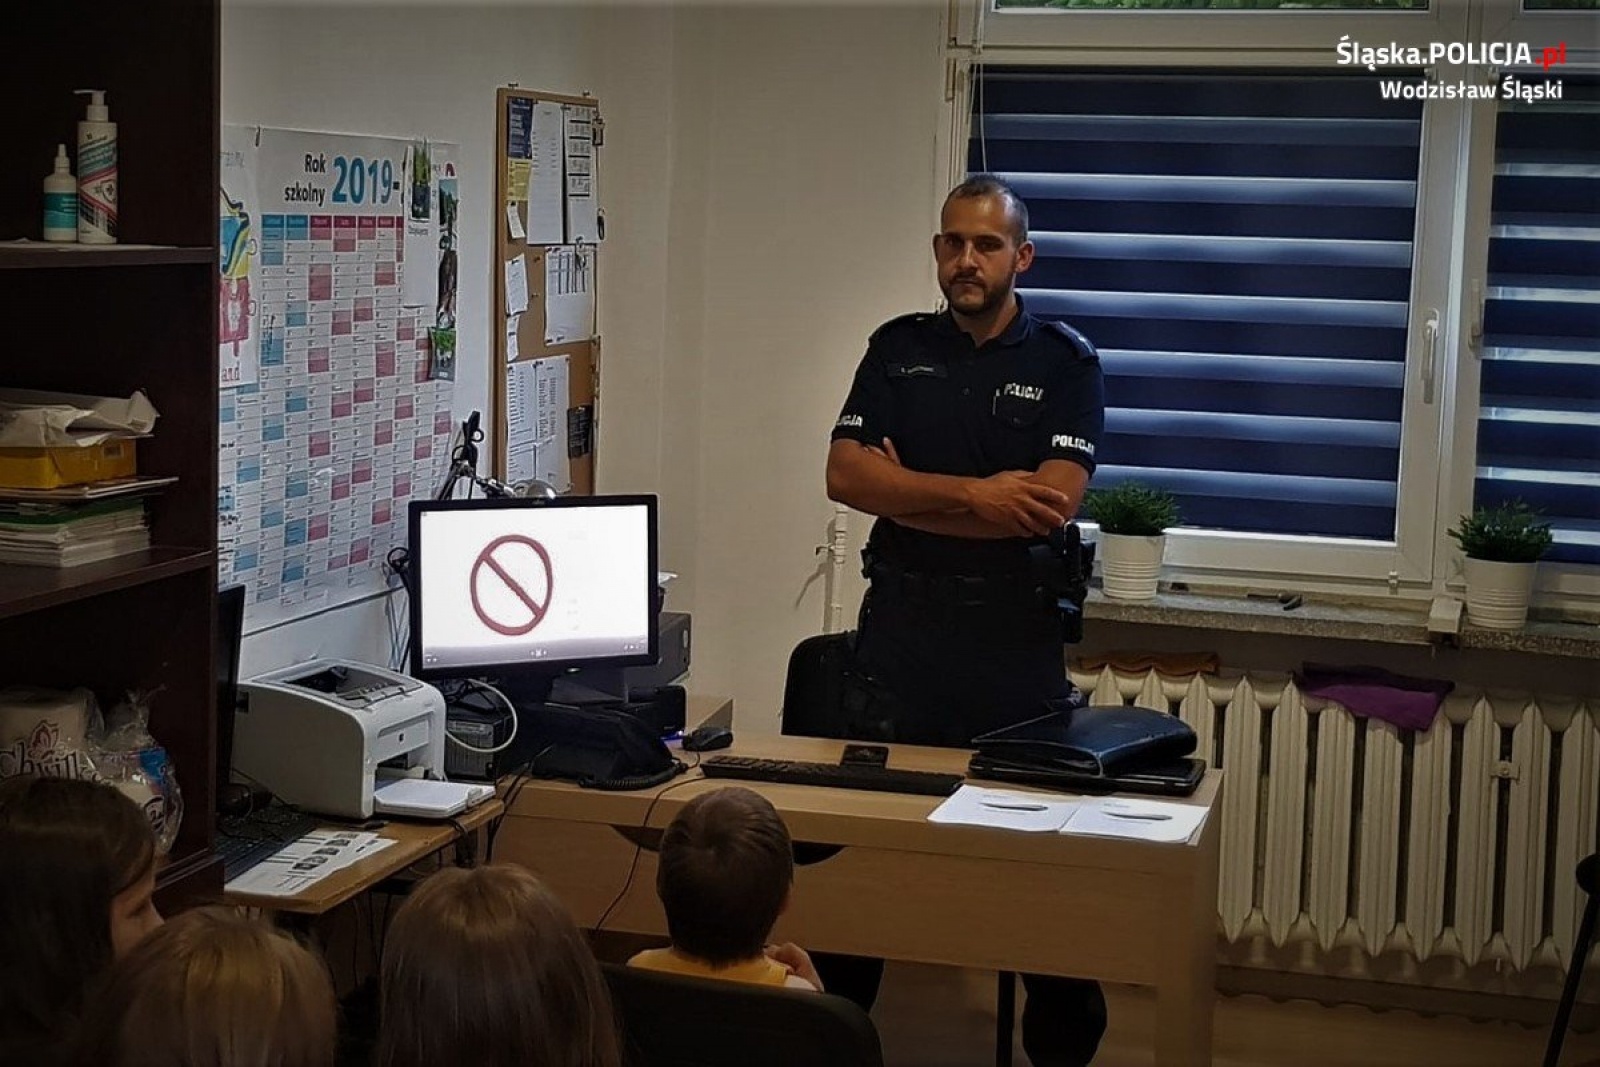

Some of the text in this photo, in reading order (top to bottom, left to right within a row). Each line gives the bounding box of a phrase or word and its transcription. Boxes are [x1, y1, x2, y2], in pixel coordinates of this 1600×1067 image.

[304, 153, 327, 174] Rok
[331, 155, 404, 205] 2019-
[284, 181, 326, 206] szkolny
